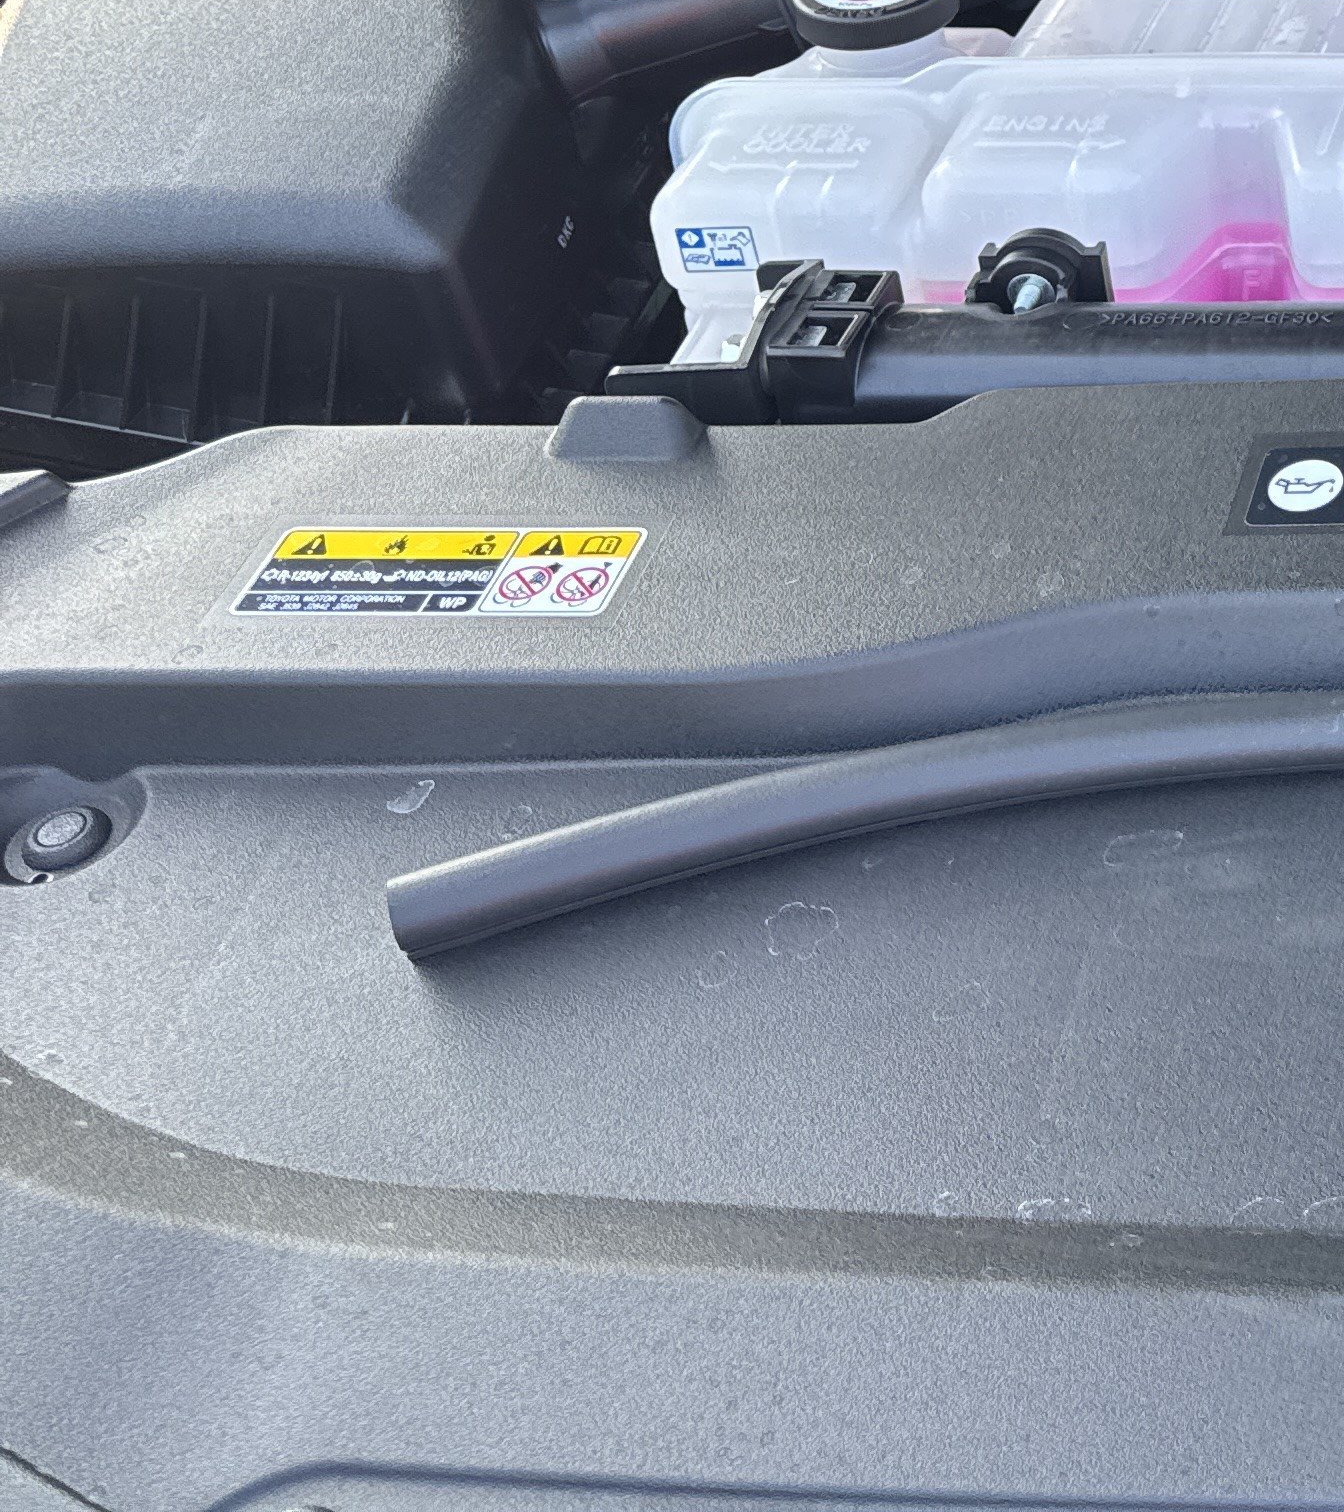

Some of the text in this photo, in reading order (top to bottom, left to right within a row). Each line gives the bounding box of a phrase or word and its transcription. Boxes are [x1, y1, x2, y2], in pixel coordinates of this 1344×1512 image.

[264, 594, 406, 604] TOYOTA MOTOR CORPORATION
[438, 596, 468, 609] WP
